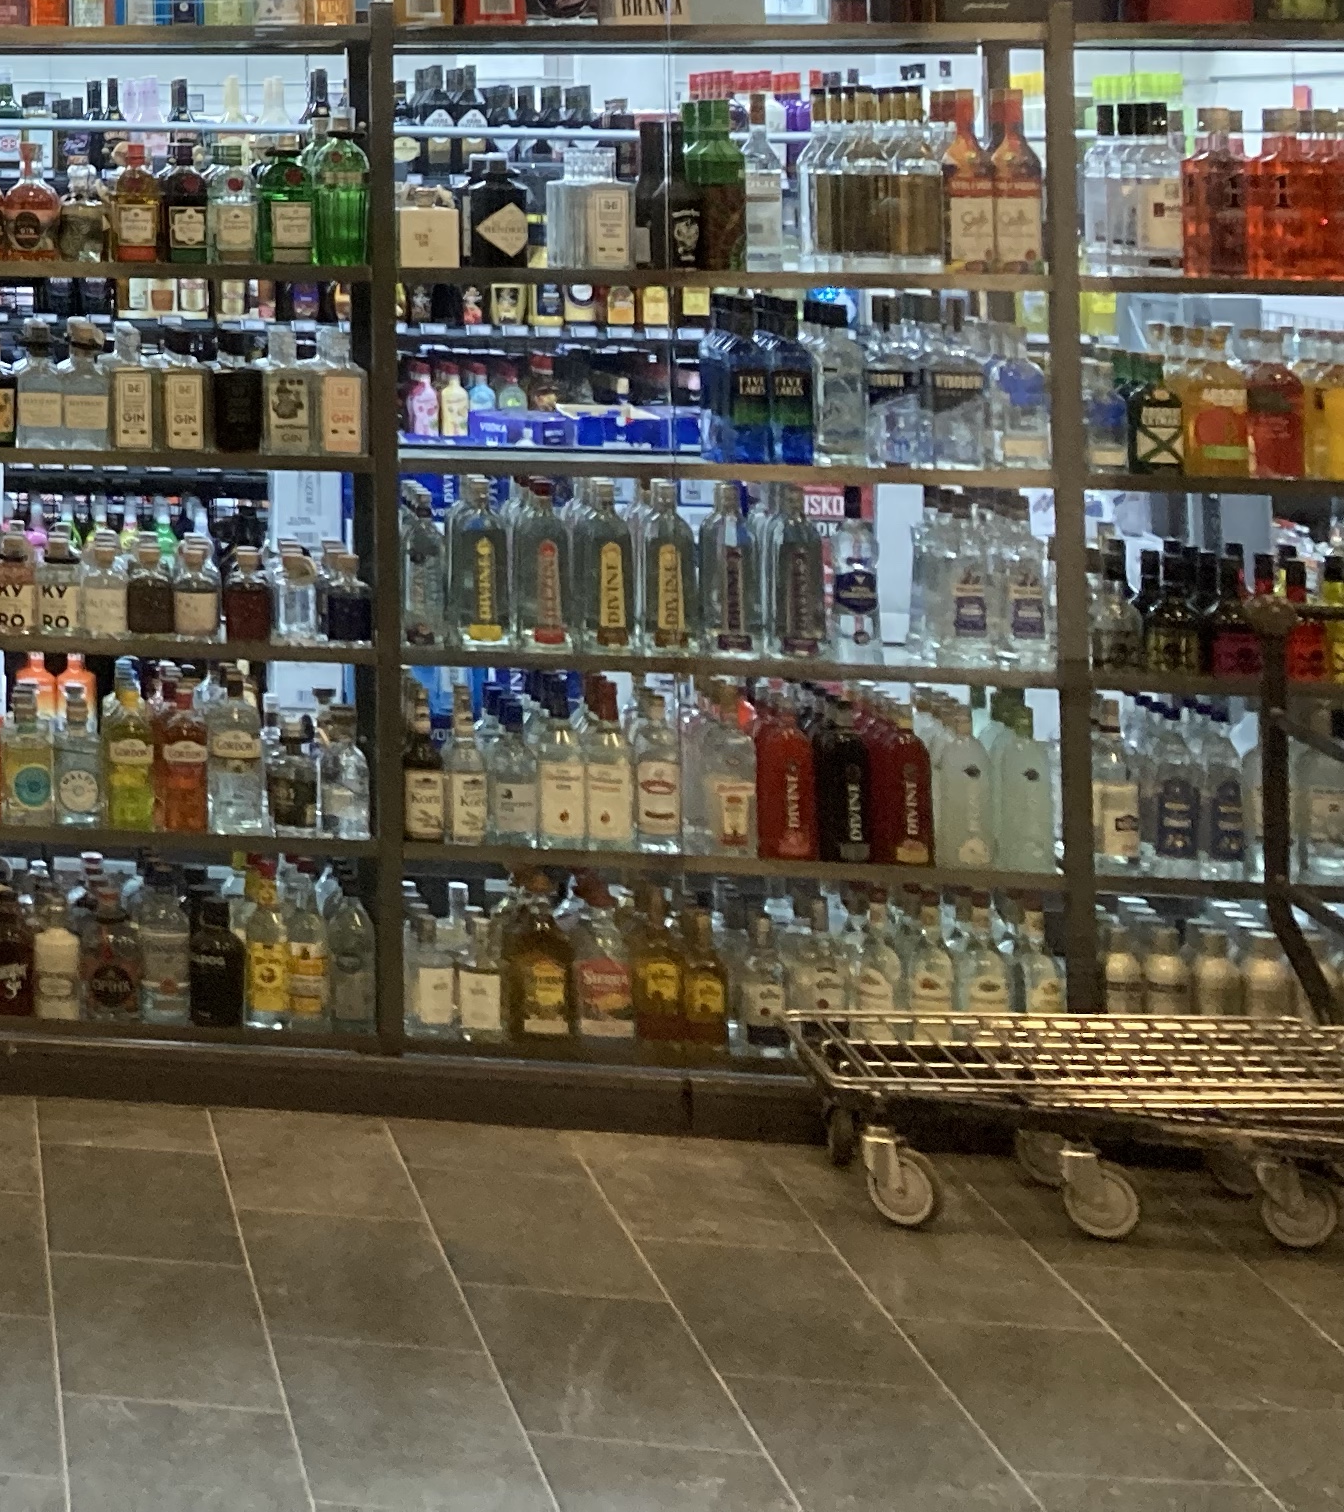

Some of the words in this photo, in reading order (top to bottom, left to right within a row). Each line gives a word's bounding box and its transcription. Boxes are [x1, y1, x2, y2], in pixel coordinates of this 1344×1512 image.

[122, 413, 145, 422] GIN
[173, 415, 197, 424] GIN
[331, 414, 354, 423] GIN
[479, 422, 508, 432] VODKA
[42, 585, 67, 599] KY
[0, 613, 24, 627] RO
[43, 615, 69, 629] RO
